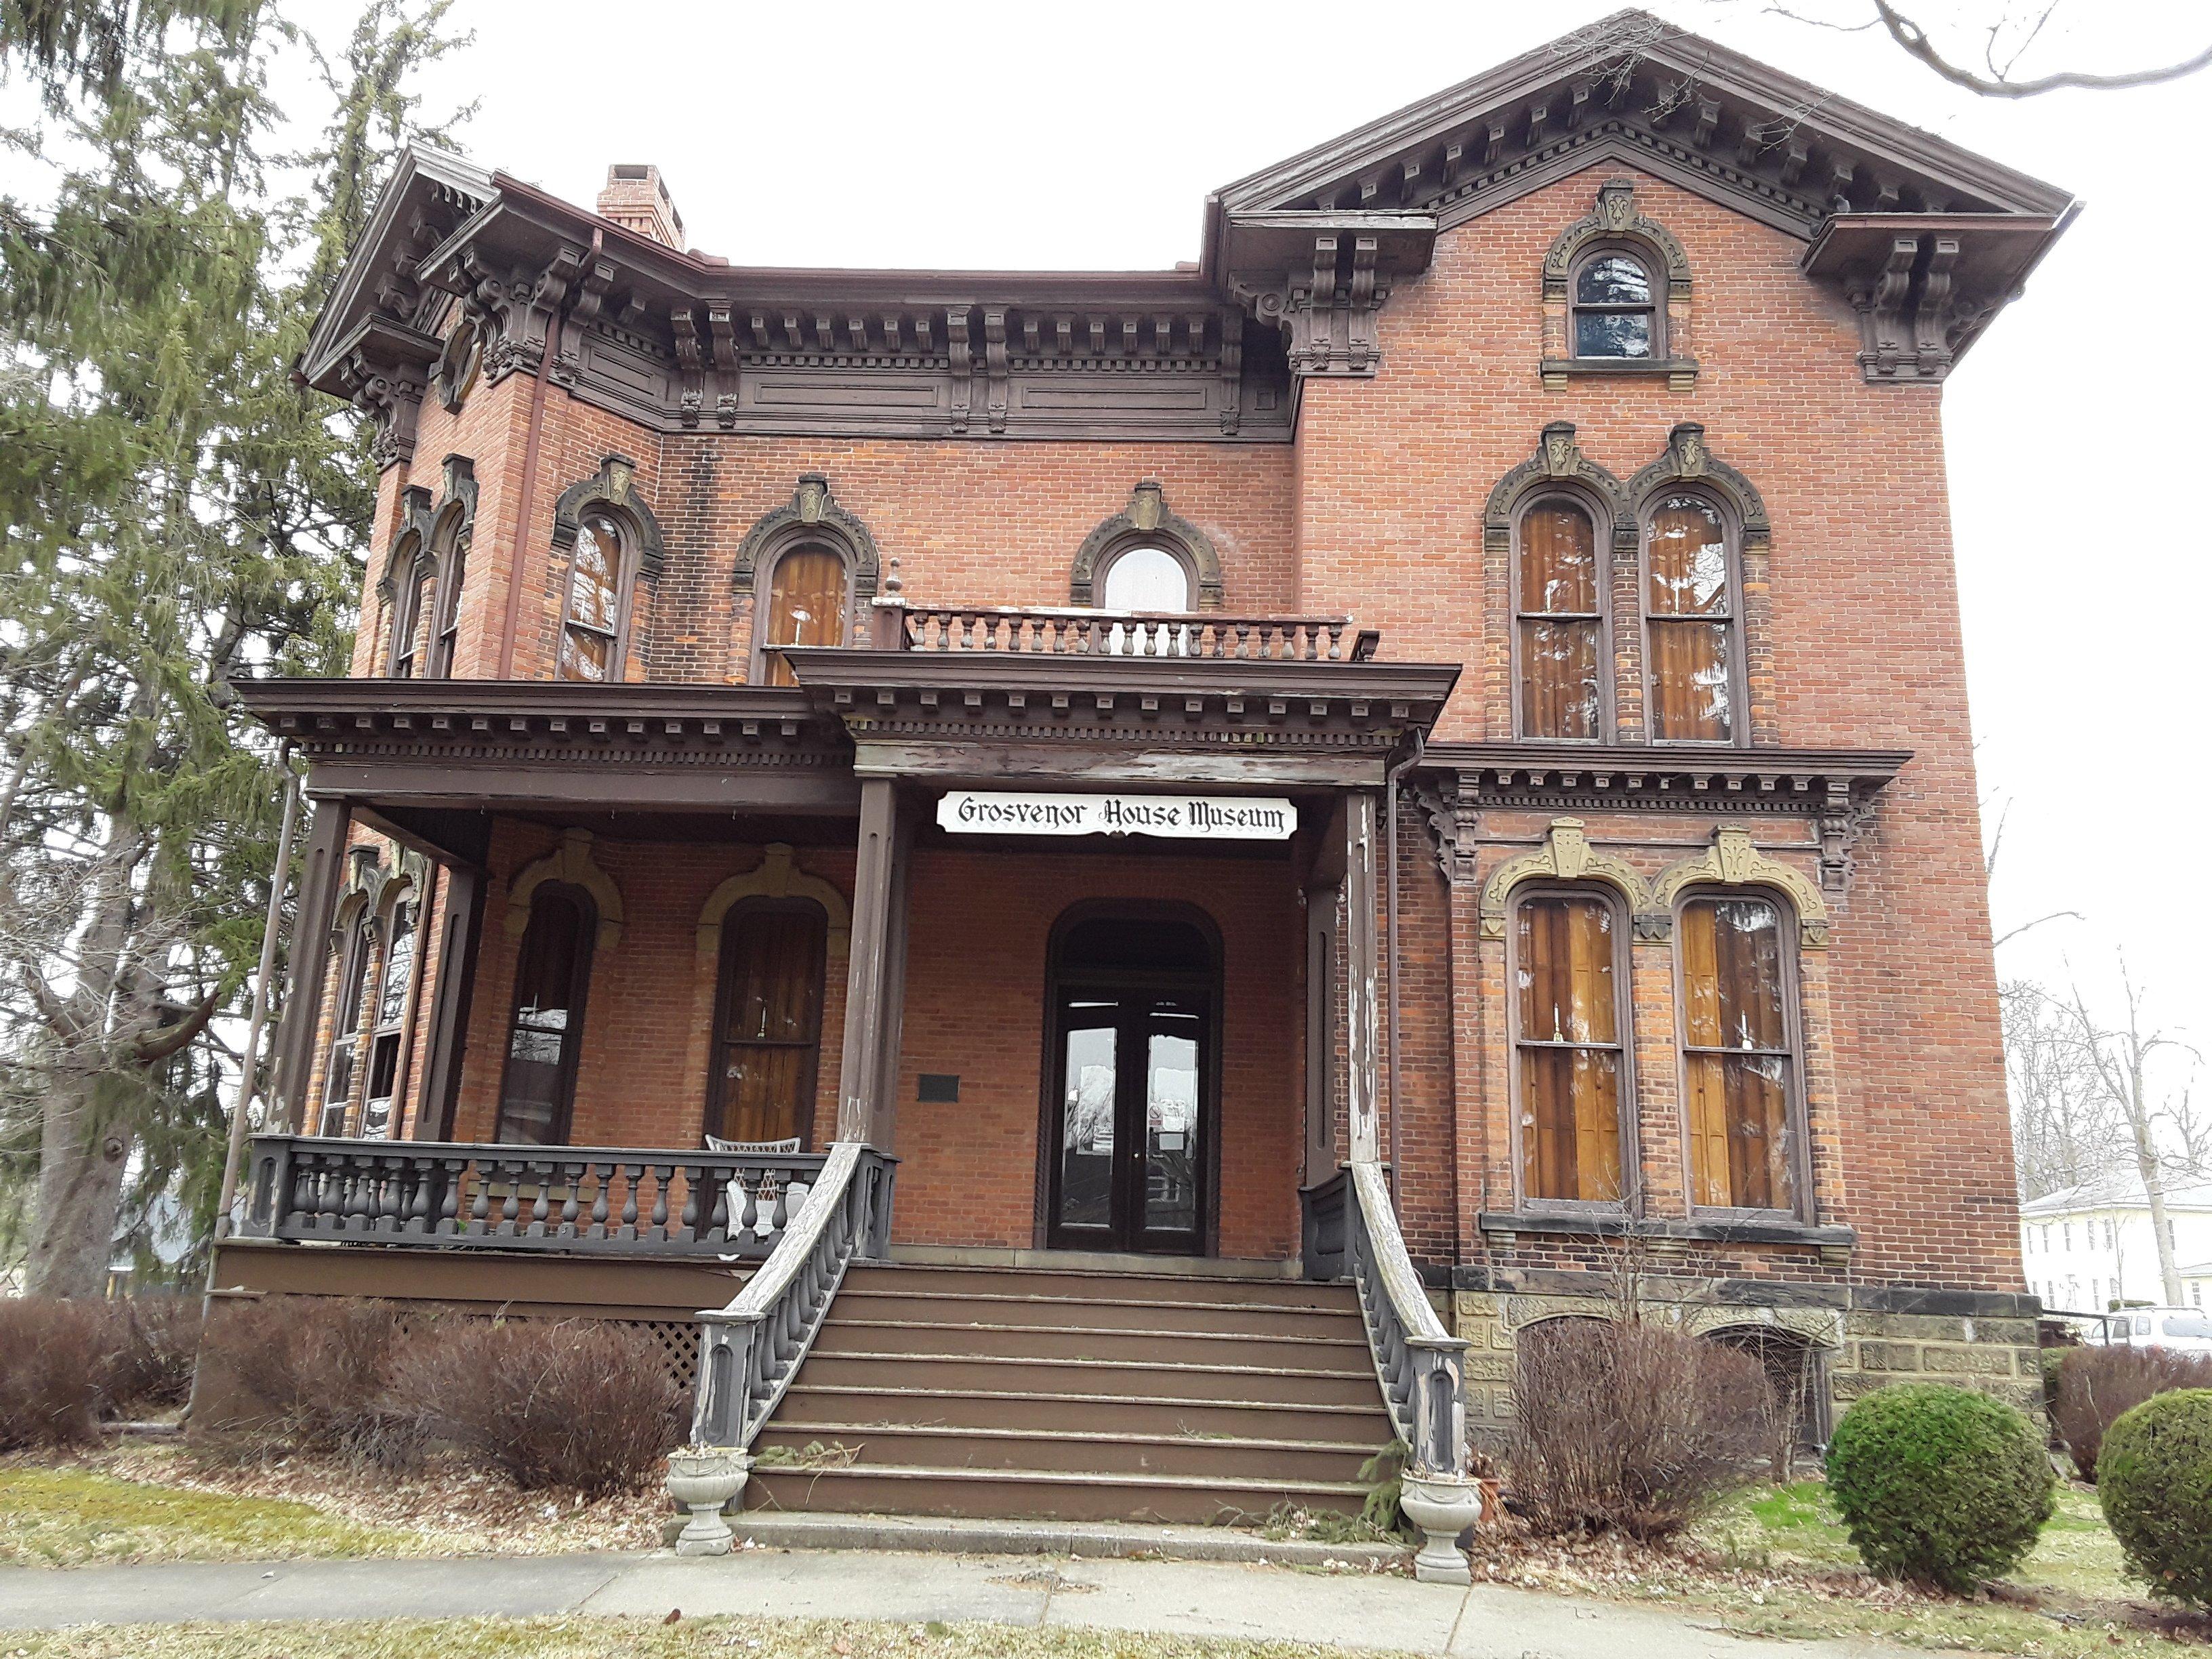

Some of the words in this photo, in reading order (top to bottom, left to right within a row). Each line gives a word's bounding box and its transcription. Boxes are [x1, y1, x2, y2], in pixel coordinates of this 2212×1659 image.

[958, 796, 1088, 830] Grosvenor
[1099, 798, 1182, 827] House
[1187, 801, 1285, 834] Museum
